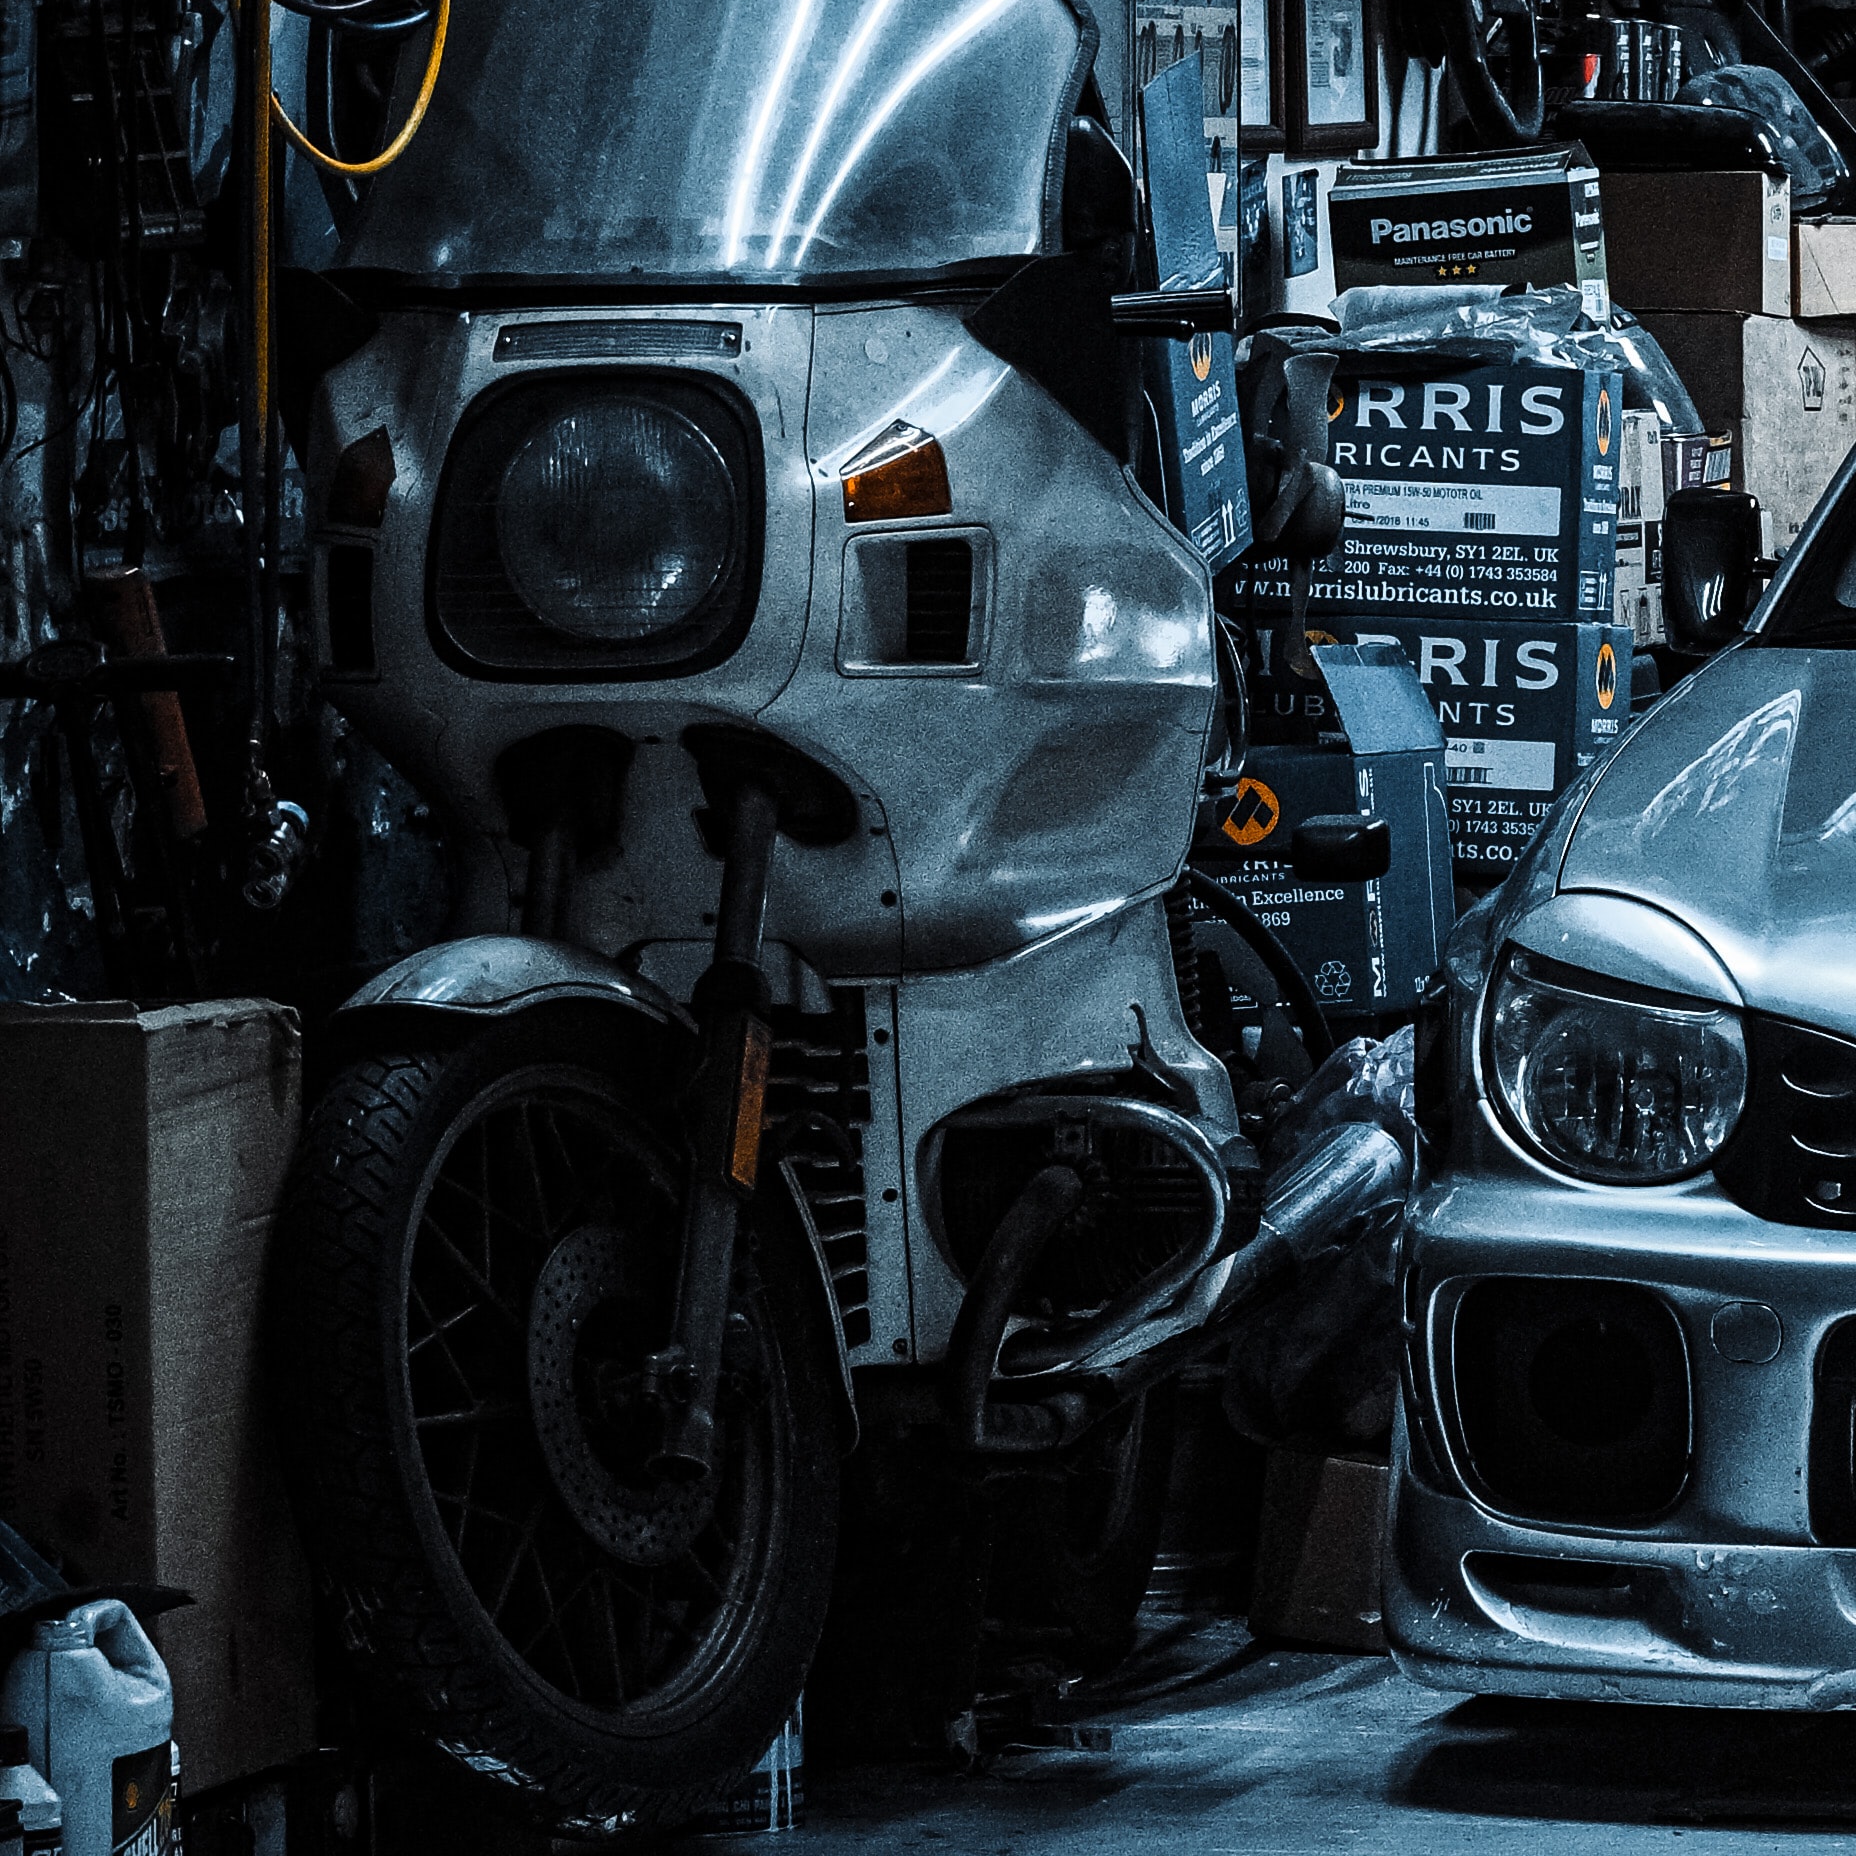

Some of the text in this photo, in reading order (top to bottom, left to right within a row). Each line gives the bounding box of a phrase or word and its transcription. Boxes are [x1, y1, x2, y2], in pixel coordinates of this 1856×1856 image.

[1370, 207, 1533, 245] Panasonic
[1394, 254, 1447, 268] MAINTENANCE
[1467, 251, 1484, 261] CAR
[1484, 248, 1517, 260] BATTERY
[1356, 380, 1566, 436] RRIS
[1334, 442, 1521, 472] RICANTS
[1361, 484, 1401, 498] PREMIUM
[1469, 488, 1483, 500] OIL
[1405, 515, 1430, 528] 11:45
[1344, 539, 1560, 564] Shrewsbury, SY1 2EL. UK
[1344, 561, 1558, 583] 200 Fax: +44 (0) 1743 353584
[1452, 798, 1485, 816] SY1
[1488, 799, 1524, 818] 2EL.
[1465, 820, 1500, 836] 1743
[1217, 871, 1286, 885] BRICANTS
[1251, 887, 1346, 907] Excellence
[1261, 911, 1291, 928] 869
